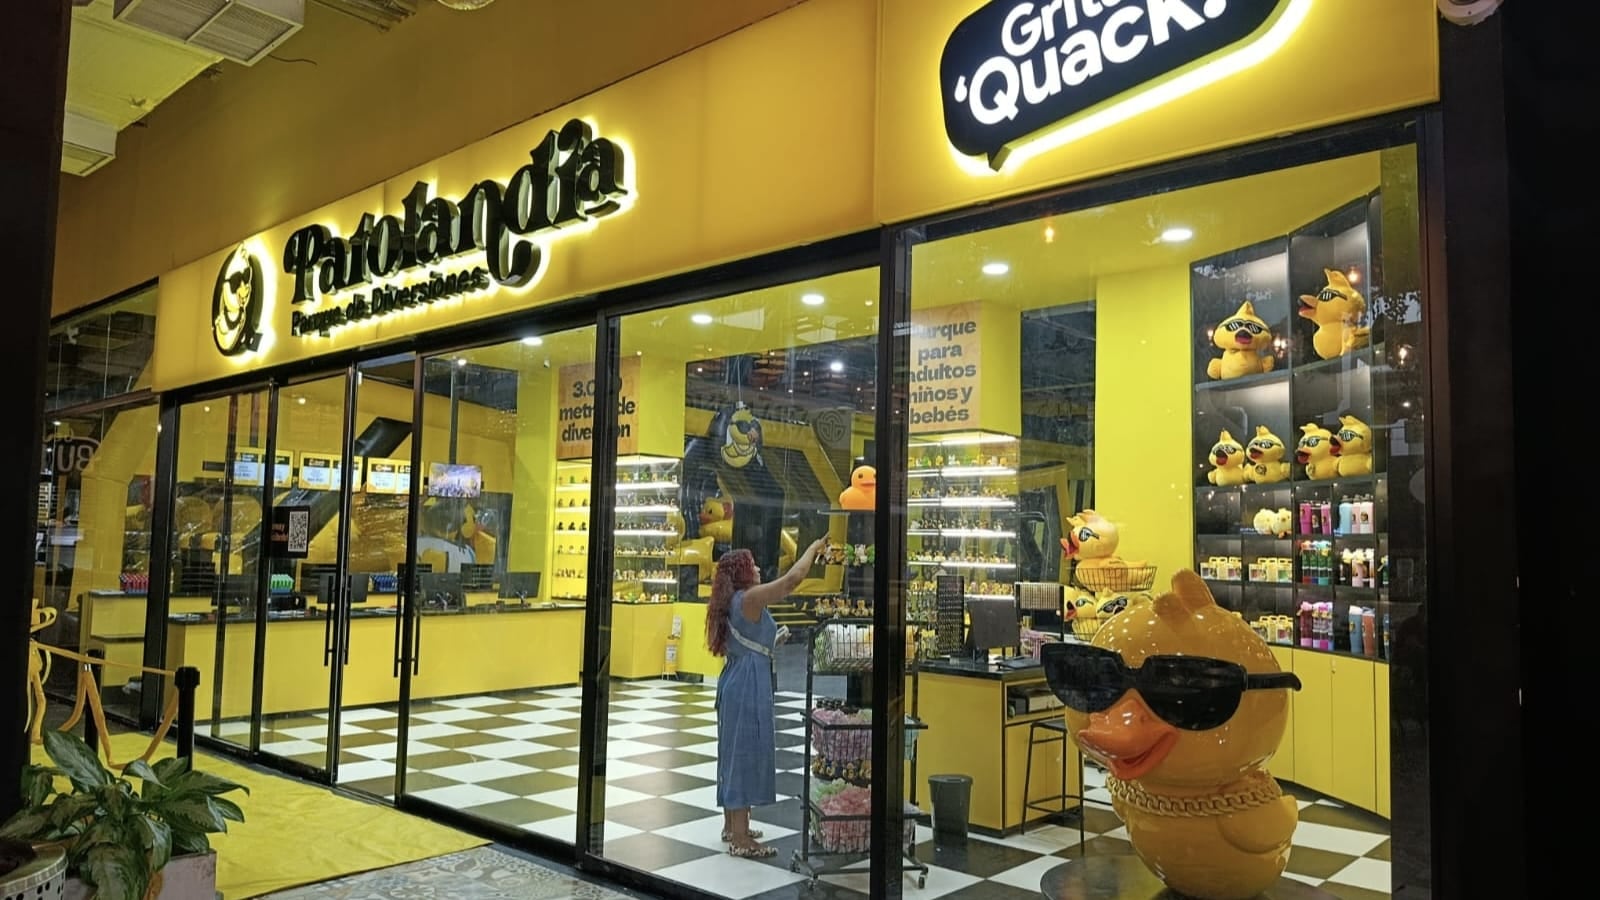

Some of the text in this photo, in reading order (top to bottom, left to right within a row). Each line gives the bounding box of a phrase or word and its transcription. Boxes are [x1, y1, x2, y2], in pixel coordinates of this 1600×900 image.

[283, 118, 628, 305] Patolandia
[291, 266, 490, 338] Parque de Diversiones
[918, 344, 962, 366] para
[960, 386, 973, 404] y
[909, 405, 970, 425] bebés
